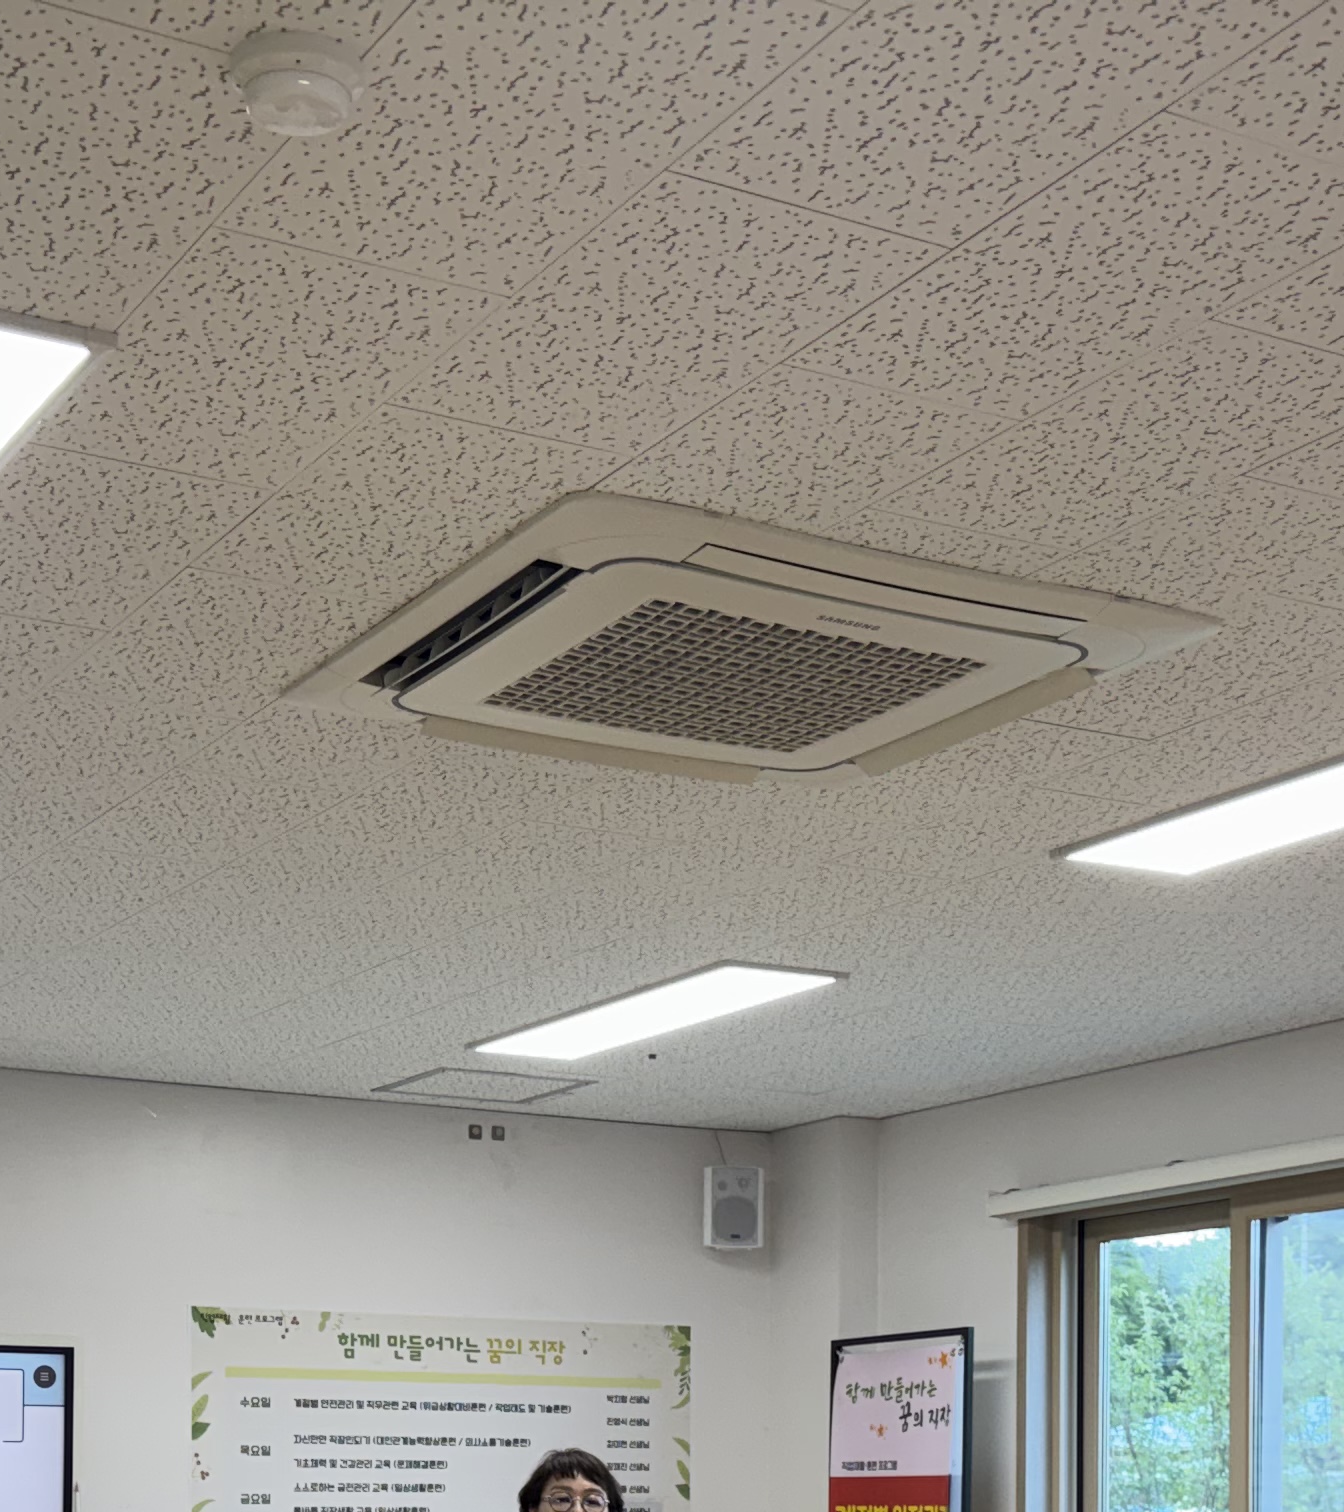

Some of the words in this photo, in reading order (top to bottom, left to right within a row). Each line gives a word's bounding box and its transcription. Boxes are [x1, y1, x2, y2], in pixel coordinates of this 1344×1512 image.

[816, 615, 881, 631] SAMSUNG
[337, 1332, 380, 1359] 함께
[387, 1335, 481, 1364] 만들어가는
[486, 1337, 522, 1364] 꿈의
[529, 1339, 566, 1366] 직장
[880, 1377, 937, 1403] 만들어가는
[240, 1397, 272, 1409] 수요일
[899, 1401, 924, 1433] 꿈의
[239, 1444, 272, 1457] 목요일
[239, 1493, 272, 1505] 금요일
